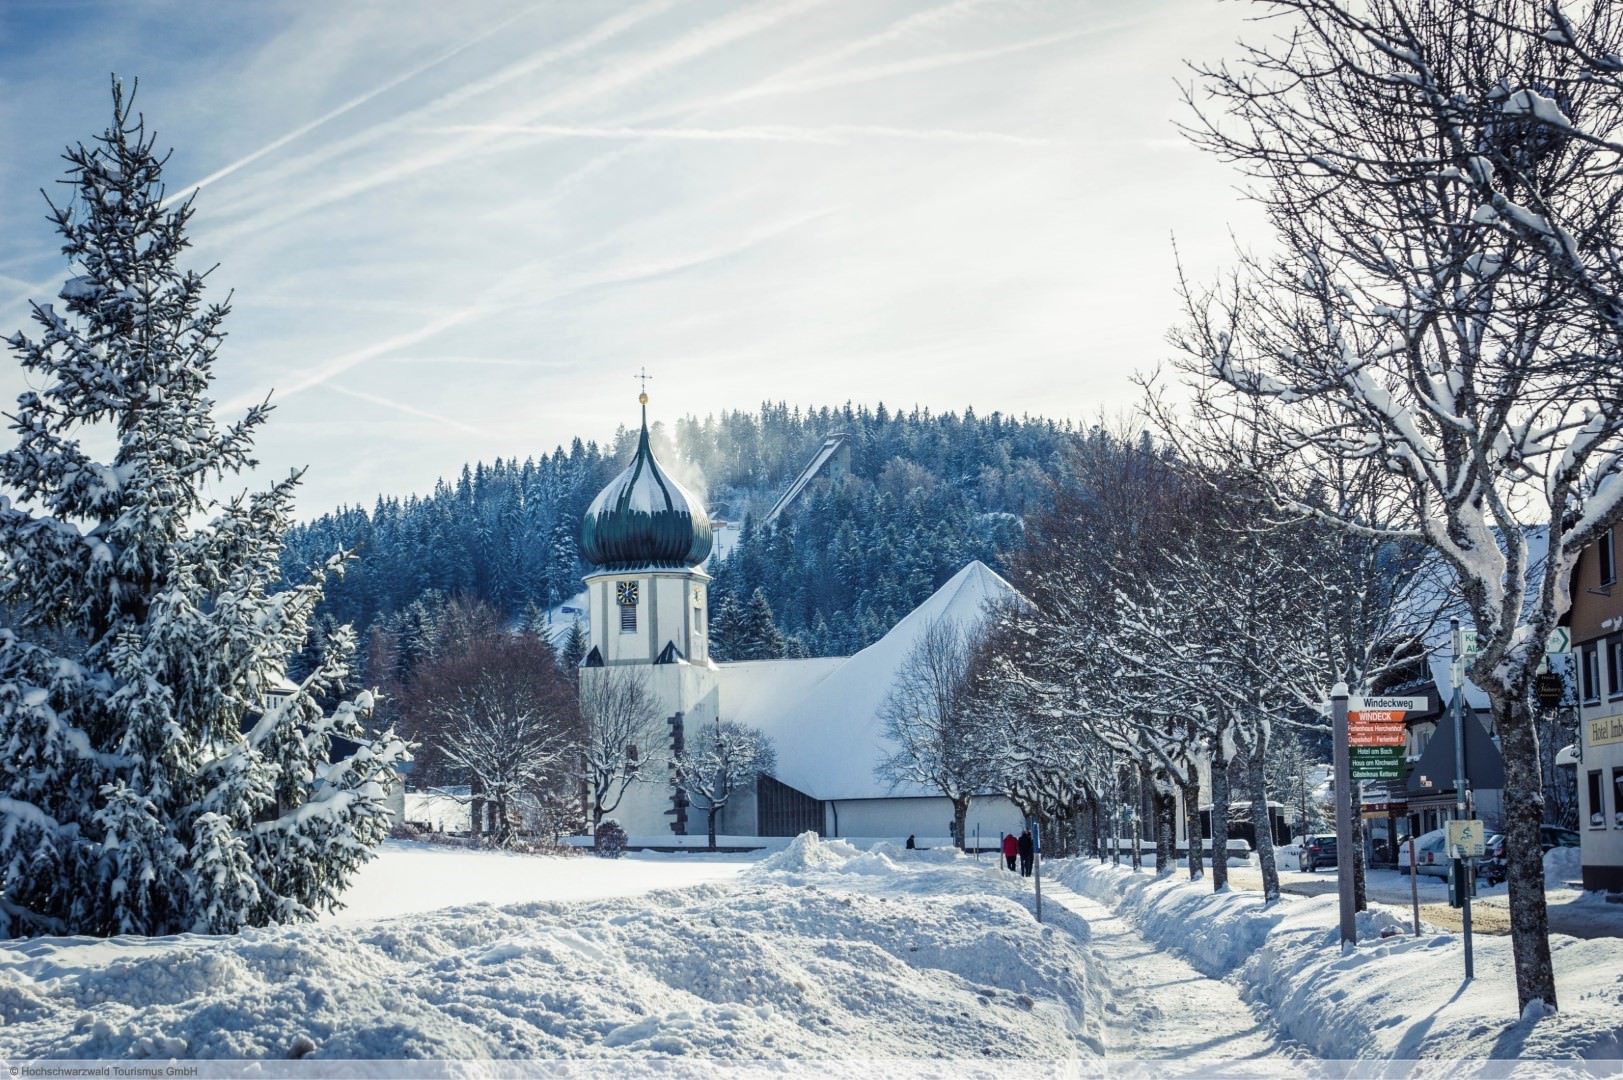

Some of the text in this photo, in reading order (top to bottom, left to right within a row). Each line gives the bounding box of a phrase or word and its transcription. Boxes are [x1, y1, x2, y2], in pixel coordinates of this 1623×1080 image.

[1363, 698, 1413, 709] Windeckweg
[1359, 712, 1392, 721] WINDECK
[1592, 720, 1608, 742] Hotel
